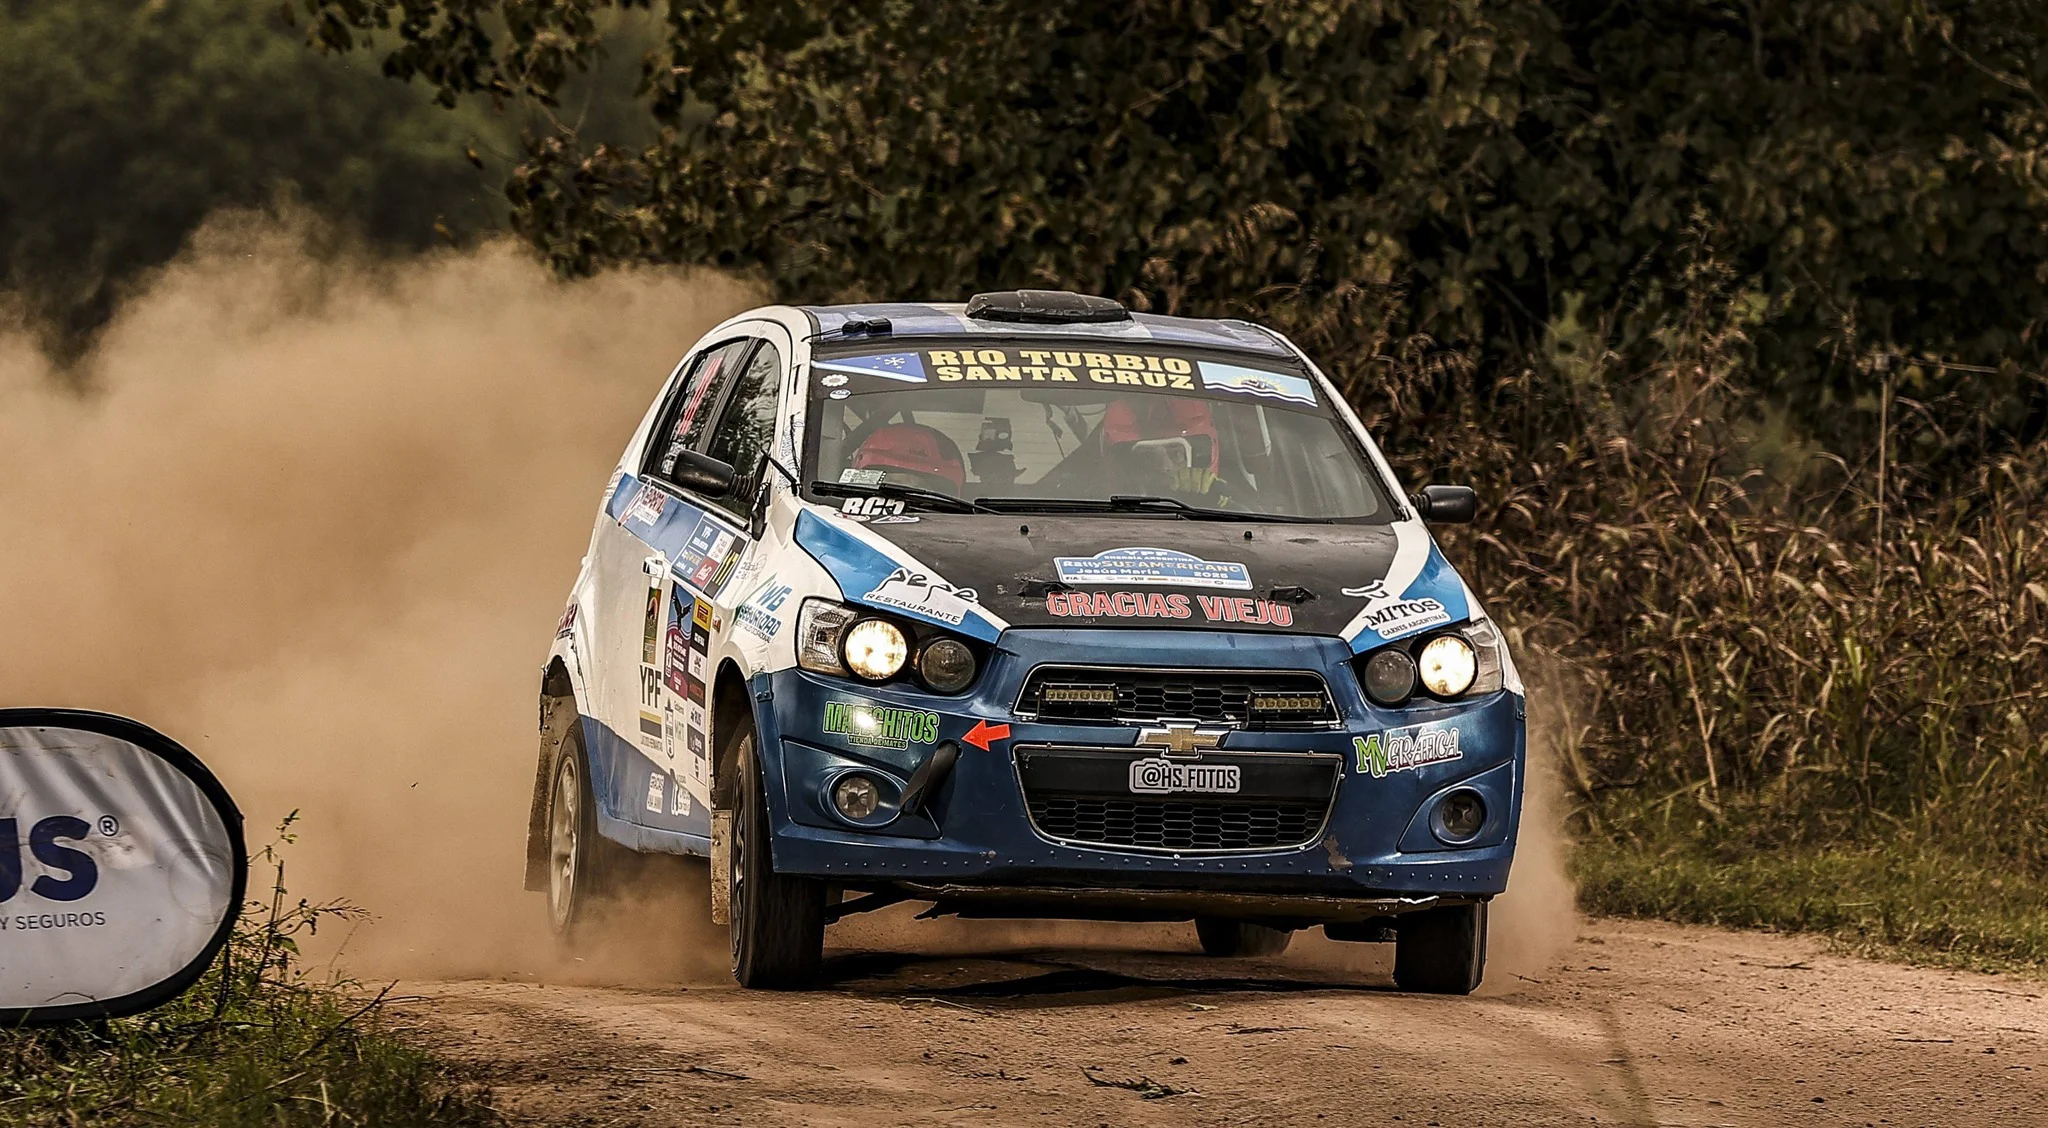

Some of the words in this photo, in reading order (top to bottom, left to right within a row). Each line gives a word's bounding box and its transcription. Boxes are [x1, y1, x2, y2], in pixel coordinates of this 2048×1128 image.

[928, 350, 1008, 366] RIO
[1020, 350, 1192, 375] TURBIO
[937, 366, 1078, 382] SANTA
[1089, 368, 1195, 390] CRUZ
[866, 594, 960, 623] RESTAURANTE
[1046, 591, 1192, 619] GRACIAS
[1197, 595, 1293, 627] VIEJO
[1363, 600, 1440, 626] MITOS
[1382, 624, 1408, 636] CARNES
[1409, 613, 1447, 628] ARGENTINAS
[640, 665, 662, 709] YPF
[849, 735, 872, 745] TIENDA
[884, 740, 906, 749] MATES
[1142, 767, 1237, 789] @HS_FOTOS
[15, 911, 106, 930] SEGUROS
